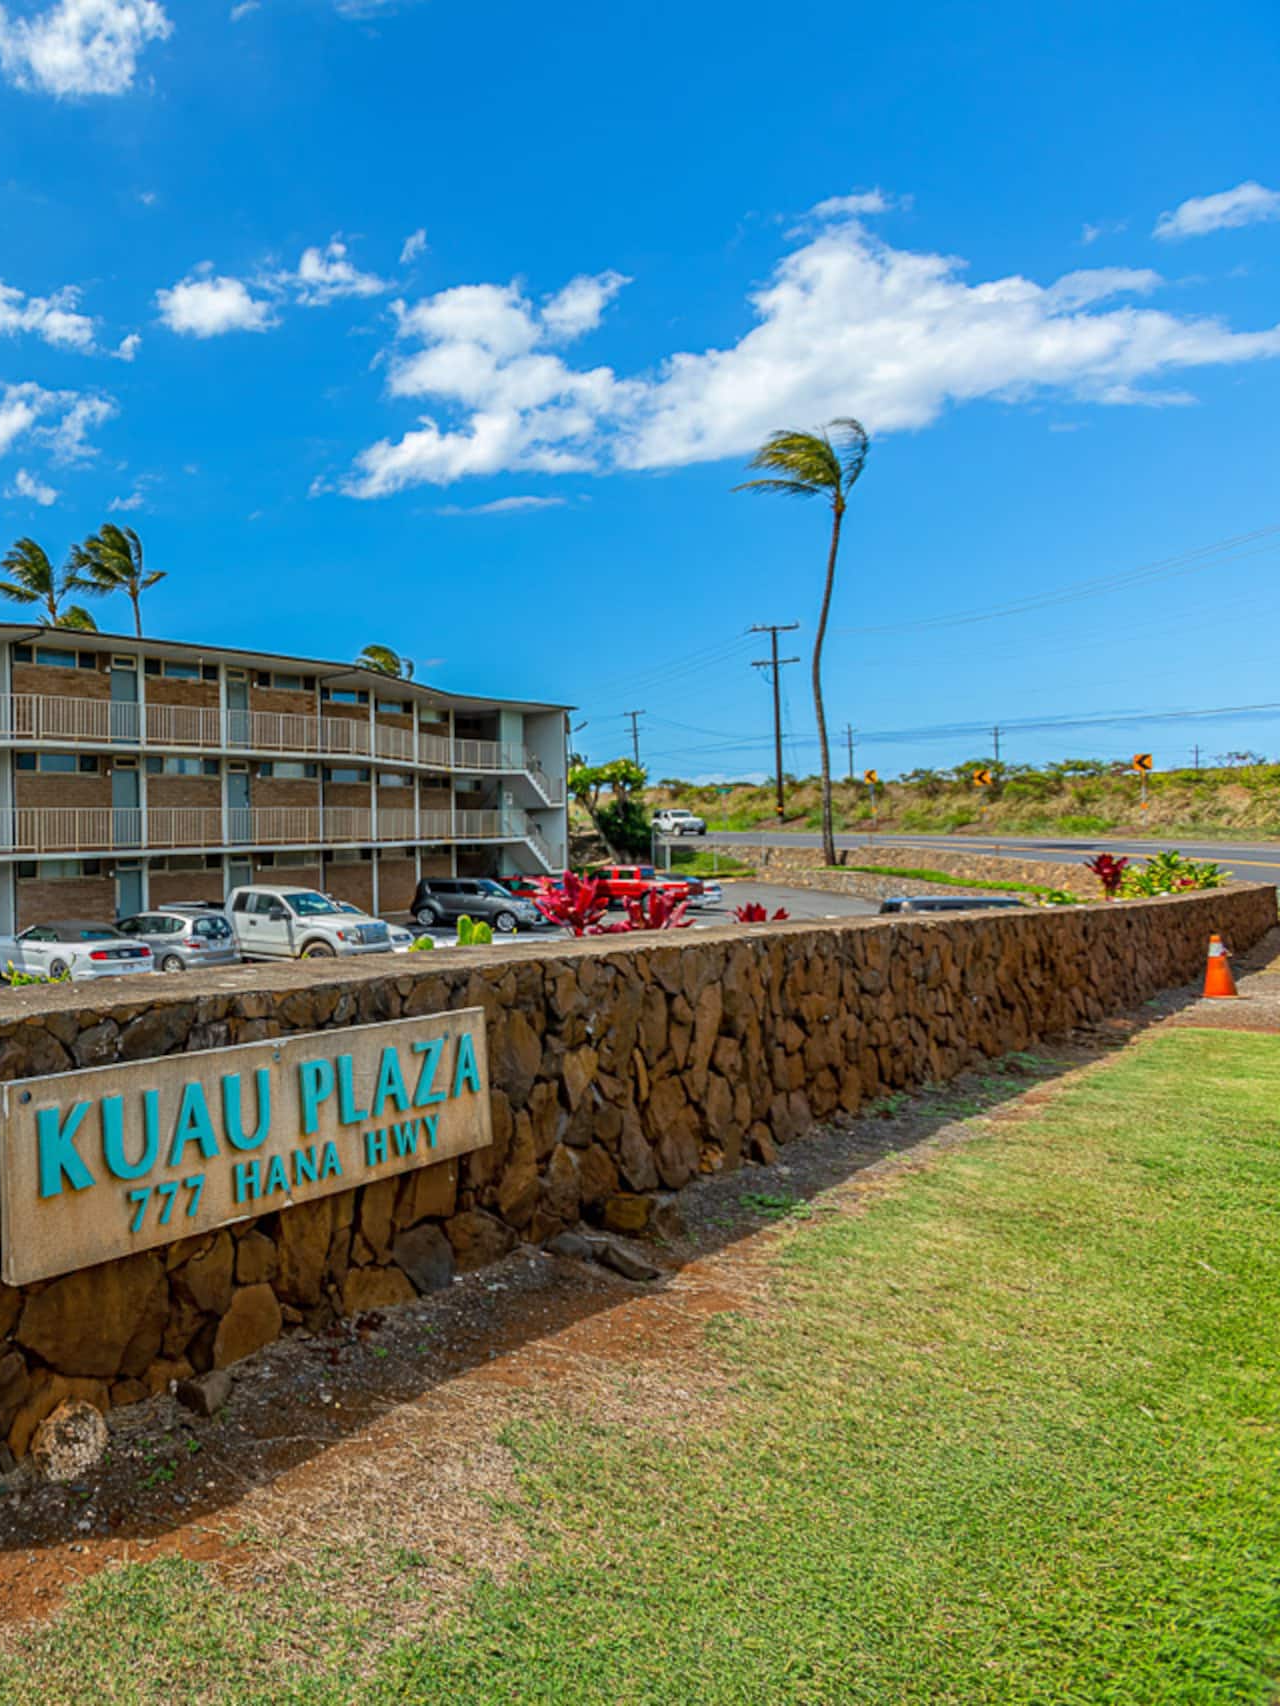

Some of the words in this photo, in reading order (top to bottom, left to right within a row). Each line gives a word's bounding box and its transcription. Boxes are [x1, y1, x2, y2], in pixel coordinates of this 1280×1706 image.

[36, 1068, 271, 1199] KUAU
[300, 1032, 482, 1136] PLAZA
[129, 1174, 206, 1233] 777
[234, 1141, 343, 1204] HANA
[366, 1113, 441, 1167] HWY
